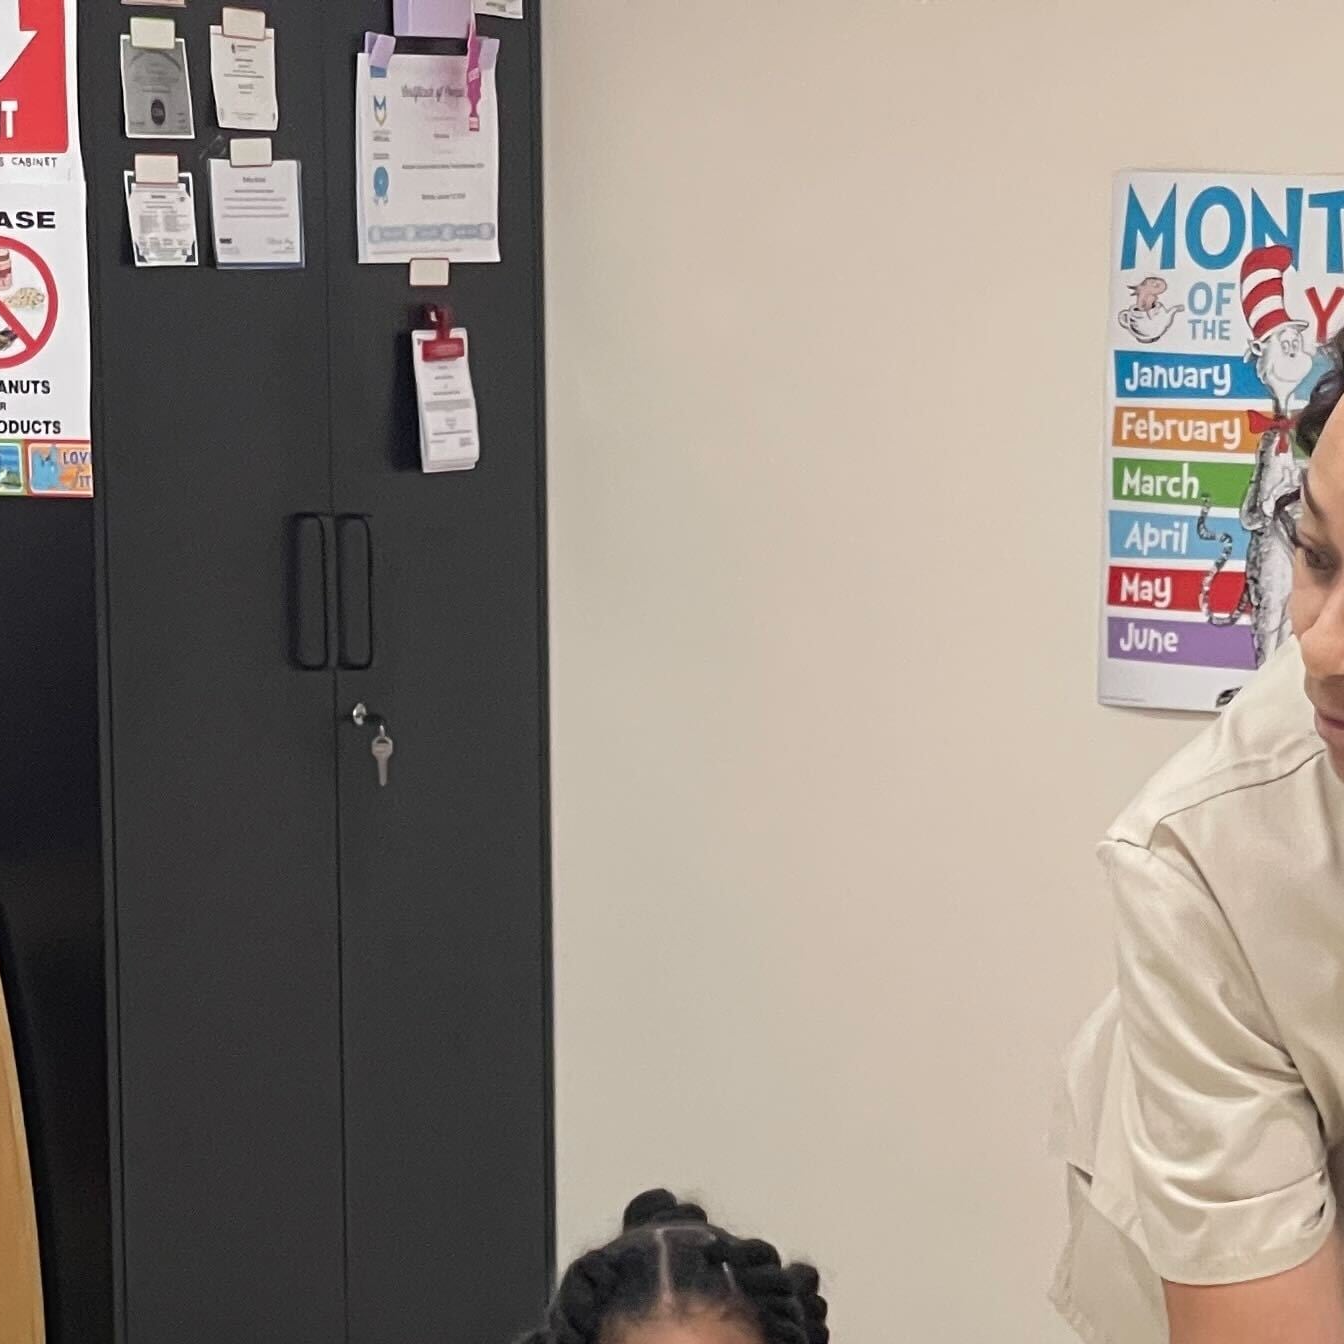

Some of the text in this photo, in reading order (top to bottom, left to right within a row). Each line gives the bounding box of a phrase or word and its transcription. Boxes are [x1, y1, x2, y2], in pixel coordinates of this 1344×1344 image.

[11, 157, 58, 168] CABINET
[1187, 281, 1236, 316] OF
[1188, 318, 1231, 341] THE
[1125, 361, 1231, 396] January
[1120, 409, 1242, 450] February
[1121, 462, 1200, 499] March
[1124, 521, 1189, 556] April
[1120, 572, 1172, 608] May
[1119, 622, 1179, 655] June
